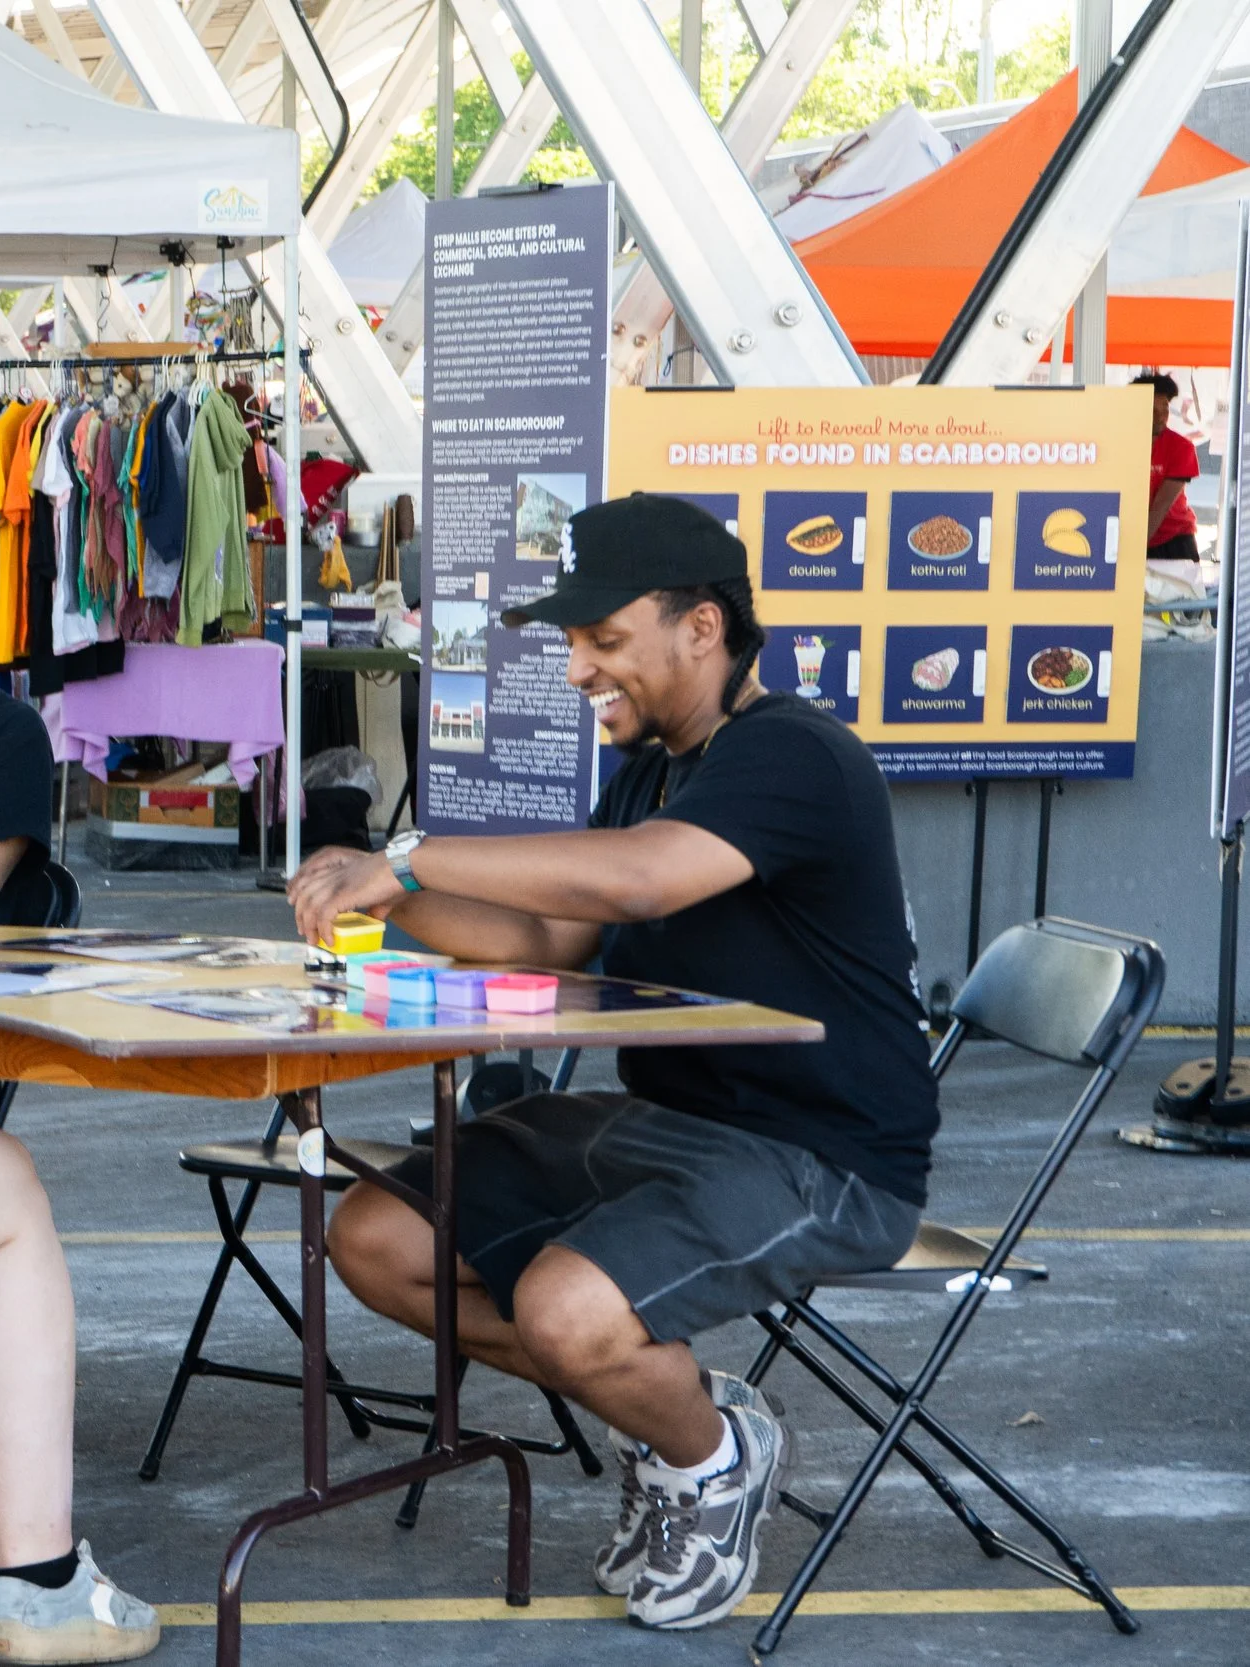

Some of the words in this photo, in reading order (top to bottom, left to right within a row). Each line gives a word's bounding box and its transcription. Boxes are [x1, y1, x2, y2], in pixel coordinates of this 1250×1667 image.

[434, 233, 454, 248] STRIP
[455, 231, 479, 246] MALLS
[480, 228, 513, 244] BECOME
[514, 226, 536, 241] SITES
[538, 224, 556, 238] FOR
[434, 246, 485, 265] COMMERCIAL,
[487, 244, 518, 261] SOCIAL,
[520, 242, 538, 256] AND
[540, 238, 585, 254] CULTURAL
[434, 263, 474, 278] EXCHANGE
[432, 419, 457, 433] WHERE
[458, 419, 468, 432] TO
[469, 418, 483, 432] EAT
[484, 418, 493, 431] IN
[494, 416, 564, 431] SCARBOROUGH?
[758, 418, 789, 442] Lift
[796, 419, 813, 436] to
[820, 417, 880, 436] Reveal
[887, 418, 929, 435] More
[669, 444, 757, 465] DISHES
[765, 444, 855, 465] FOUND
[862, 444, 890, 465] IN
[898, 444, 1096, 465] SCARBOROUGH
[789, 564, 836, 578] doubles
[910, 564, 944, 576] kothu
[946, 564, 966, 576] roti
[1035, 564, 1061, 576] beef
[1064, 564, 1096, 580] patty
[809, 698, 836, 710] halo
[902, 698, 966, 710] shawarma
[1023, 698, 1043, 714] jerk
[1046, 698, 1092, 710] chicken
